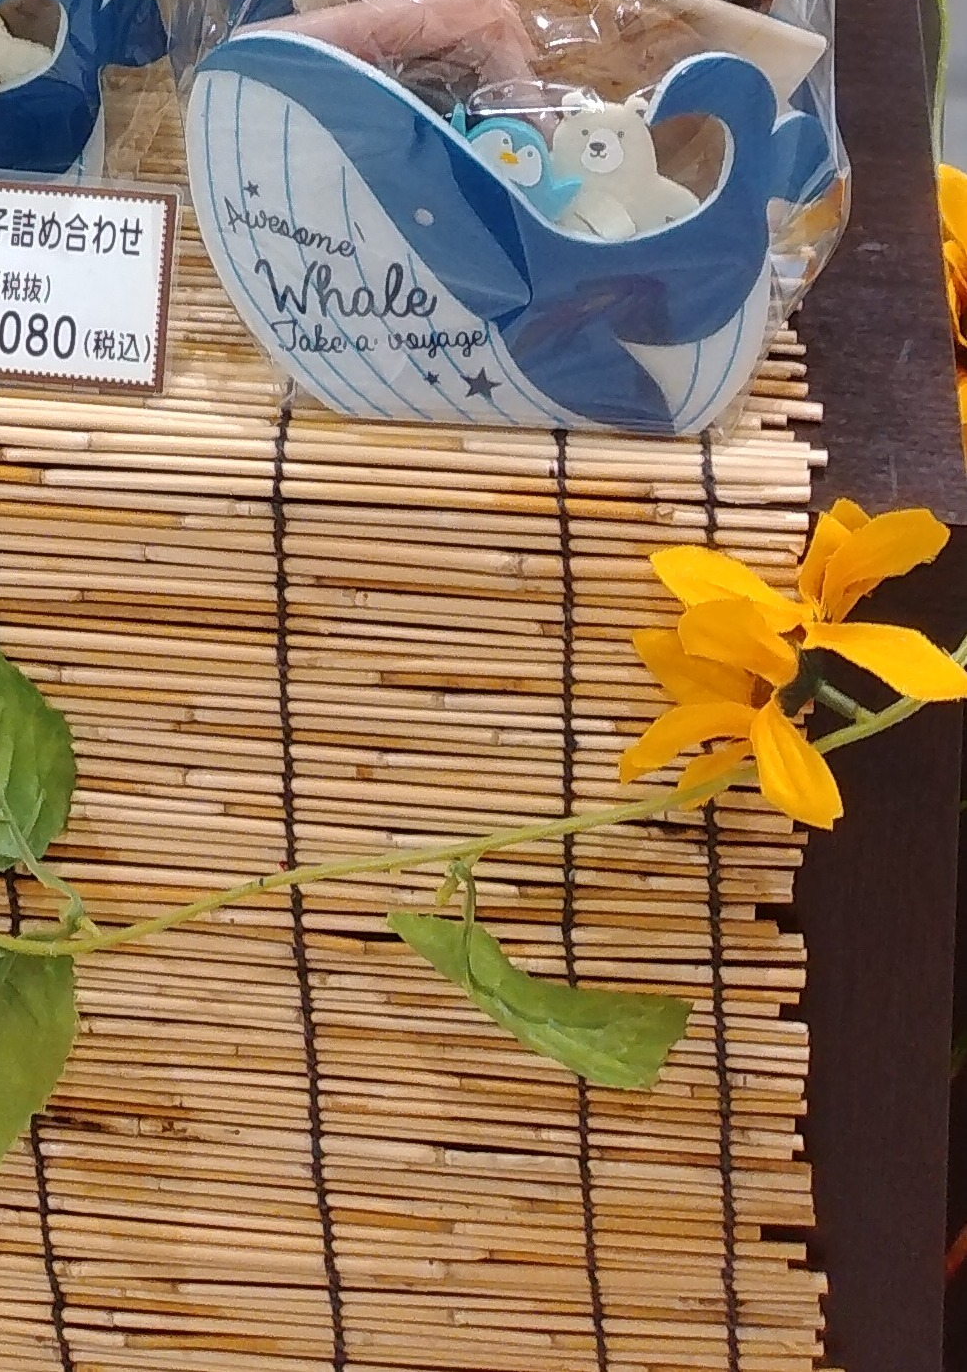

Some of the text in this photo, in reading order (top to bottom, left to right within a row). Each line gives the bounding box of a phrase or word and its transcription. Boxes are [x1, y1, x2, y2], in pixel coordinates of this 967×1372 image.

[223, 195, 356, 258] Awesome
[253, 258, 438, 319] Whale
[269, 319, 488, 359] Take a voyage
